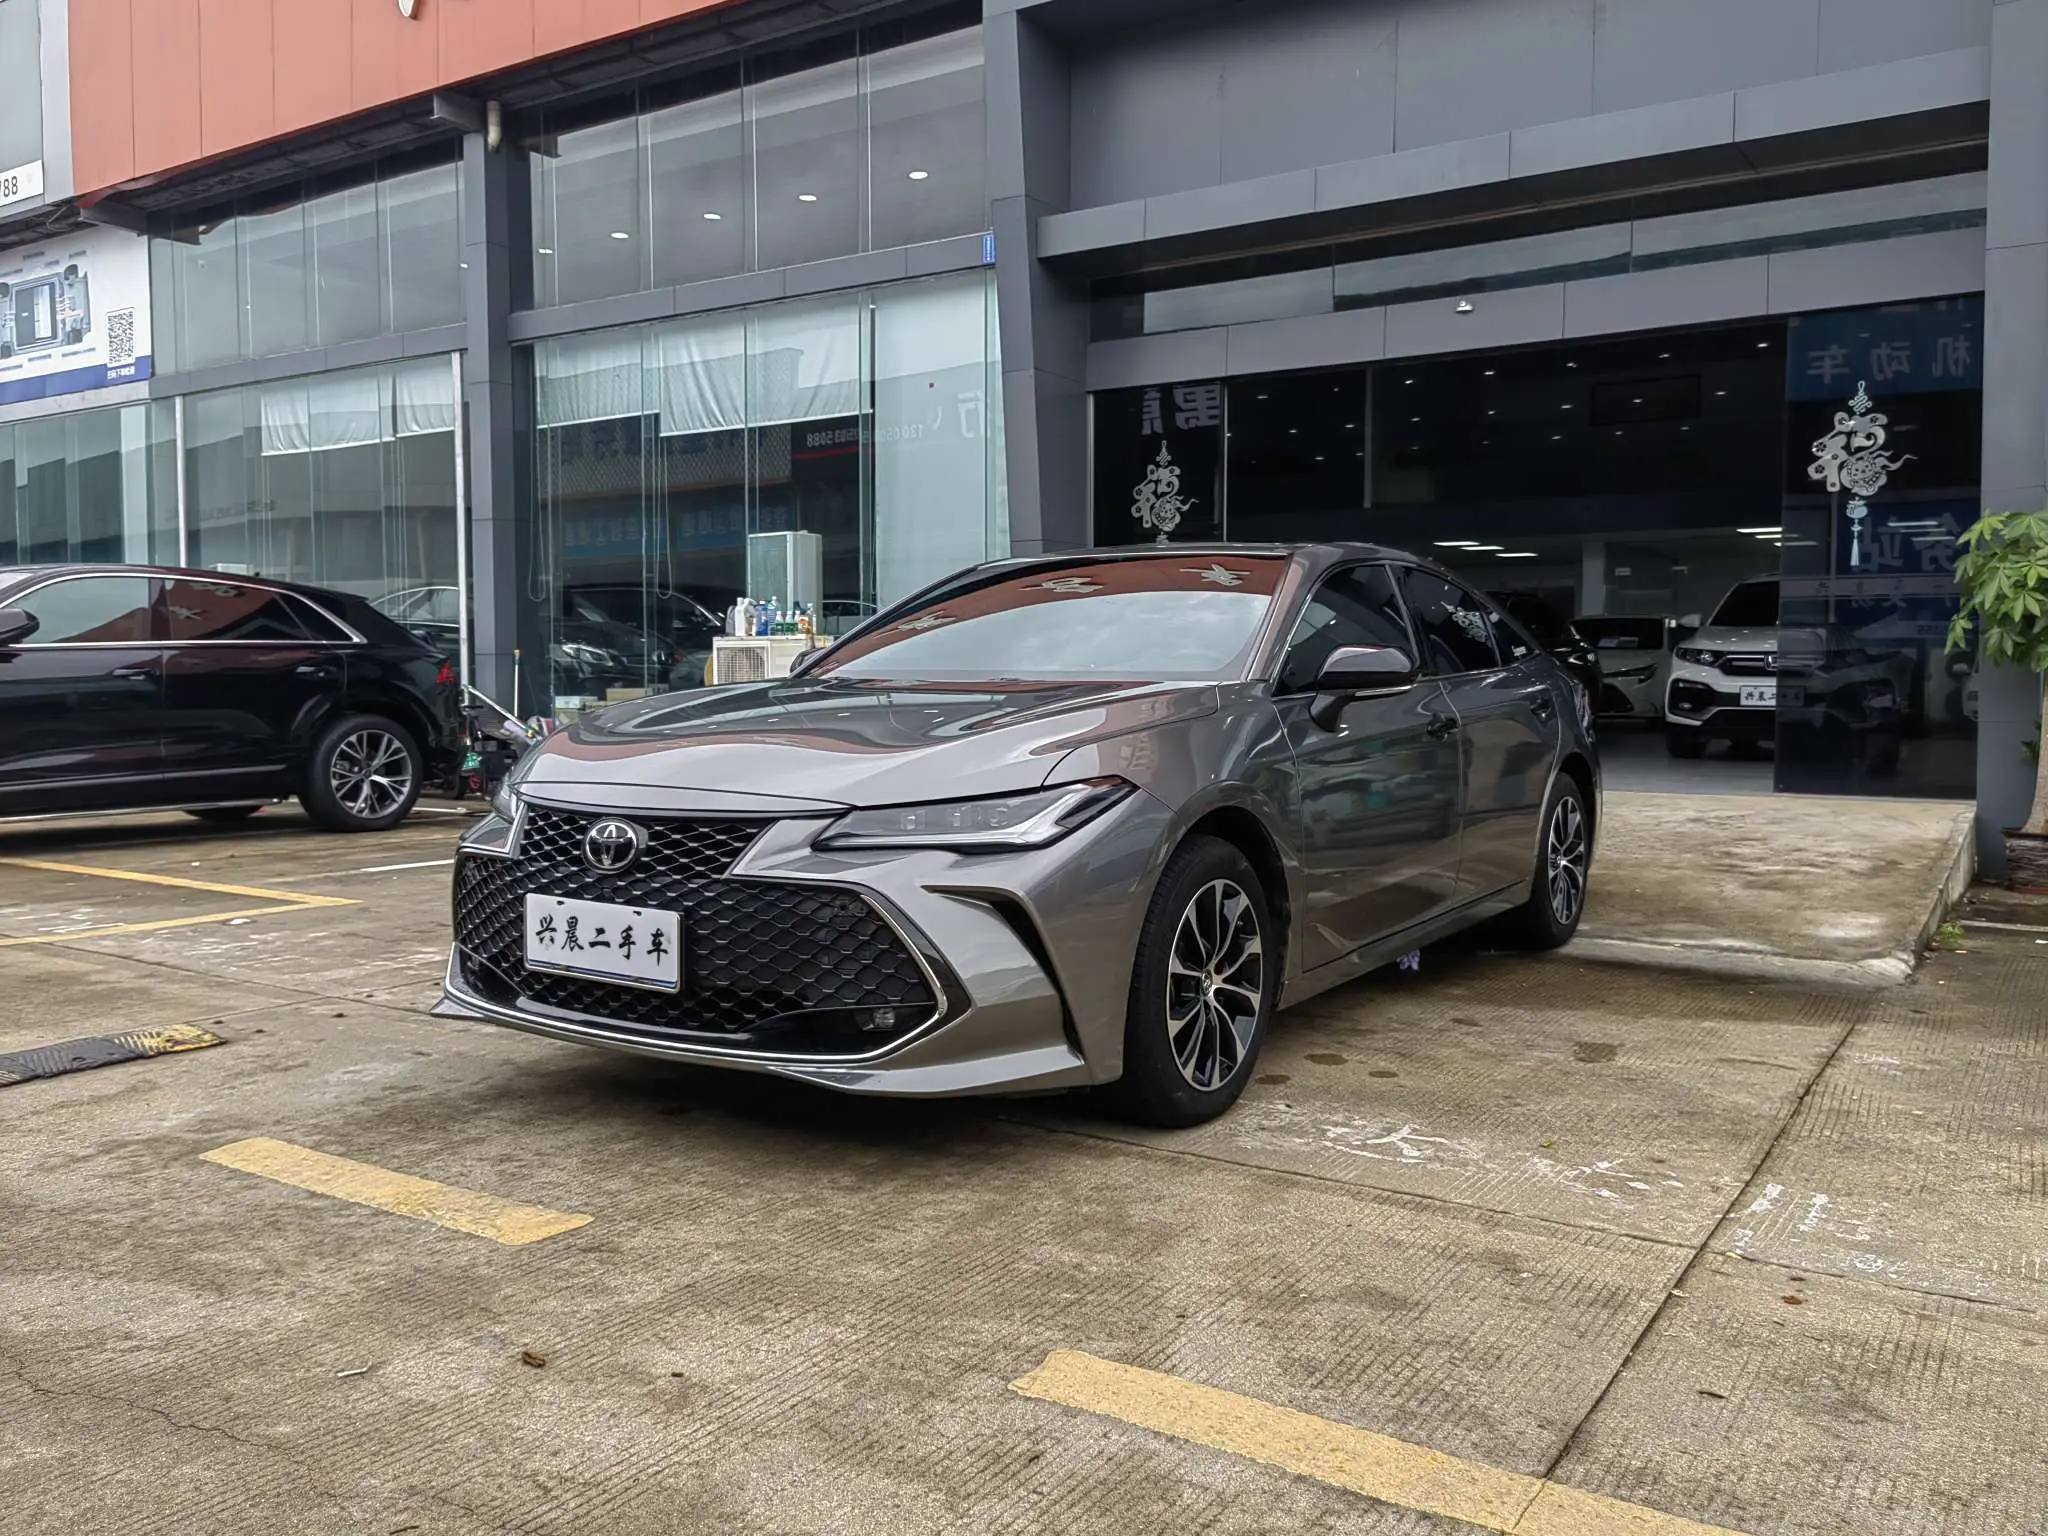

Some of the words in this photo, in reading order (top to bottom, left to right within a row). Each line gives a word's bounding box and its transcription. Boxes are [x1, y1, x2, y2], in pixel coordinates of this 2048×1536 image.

[535, 914, 669, 967] 兴晨二手车
